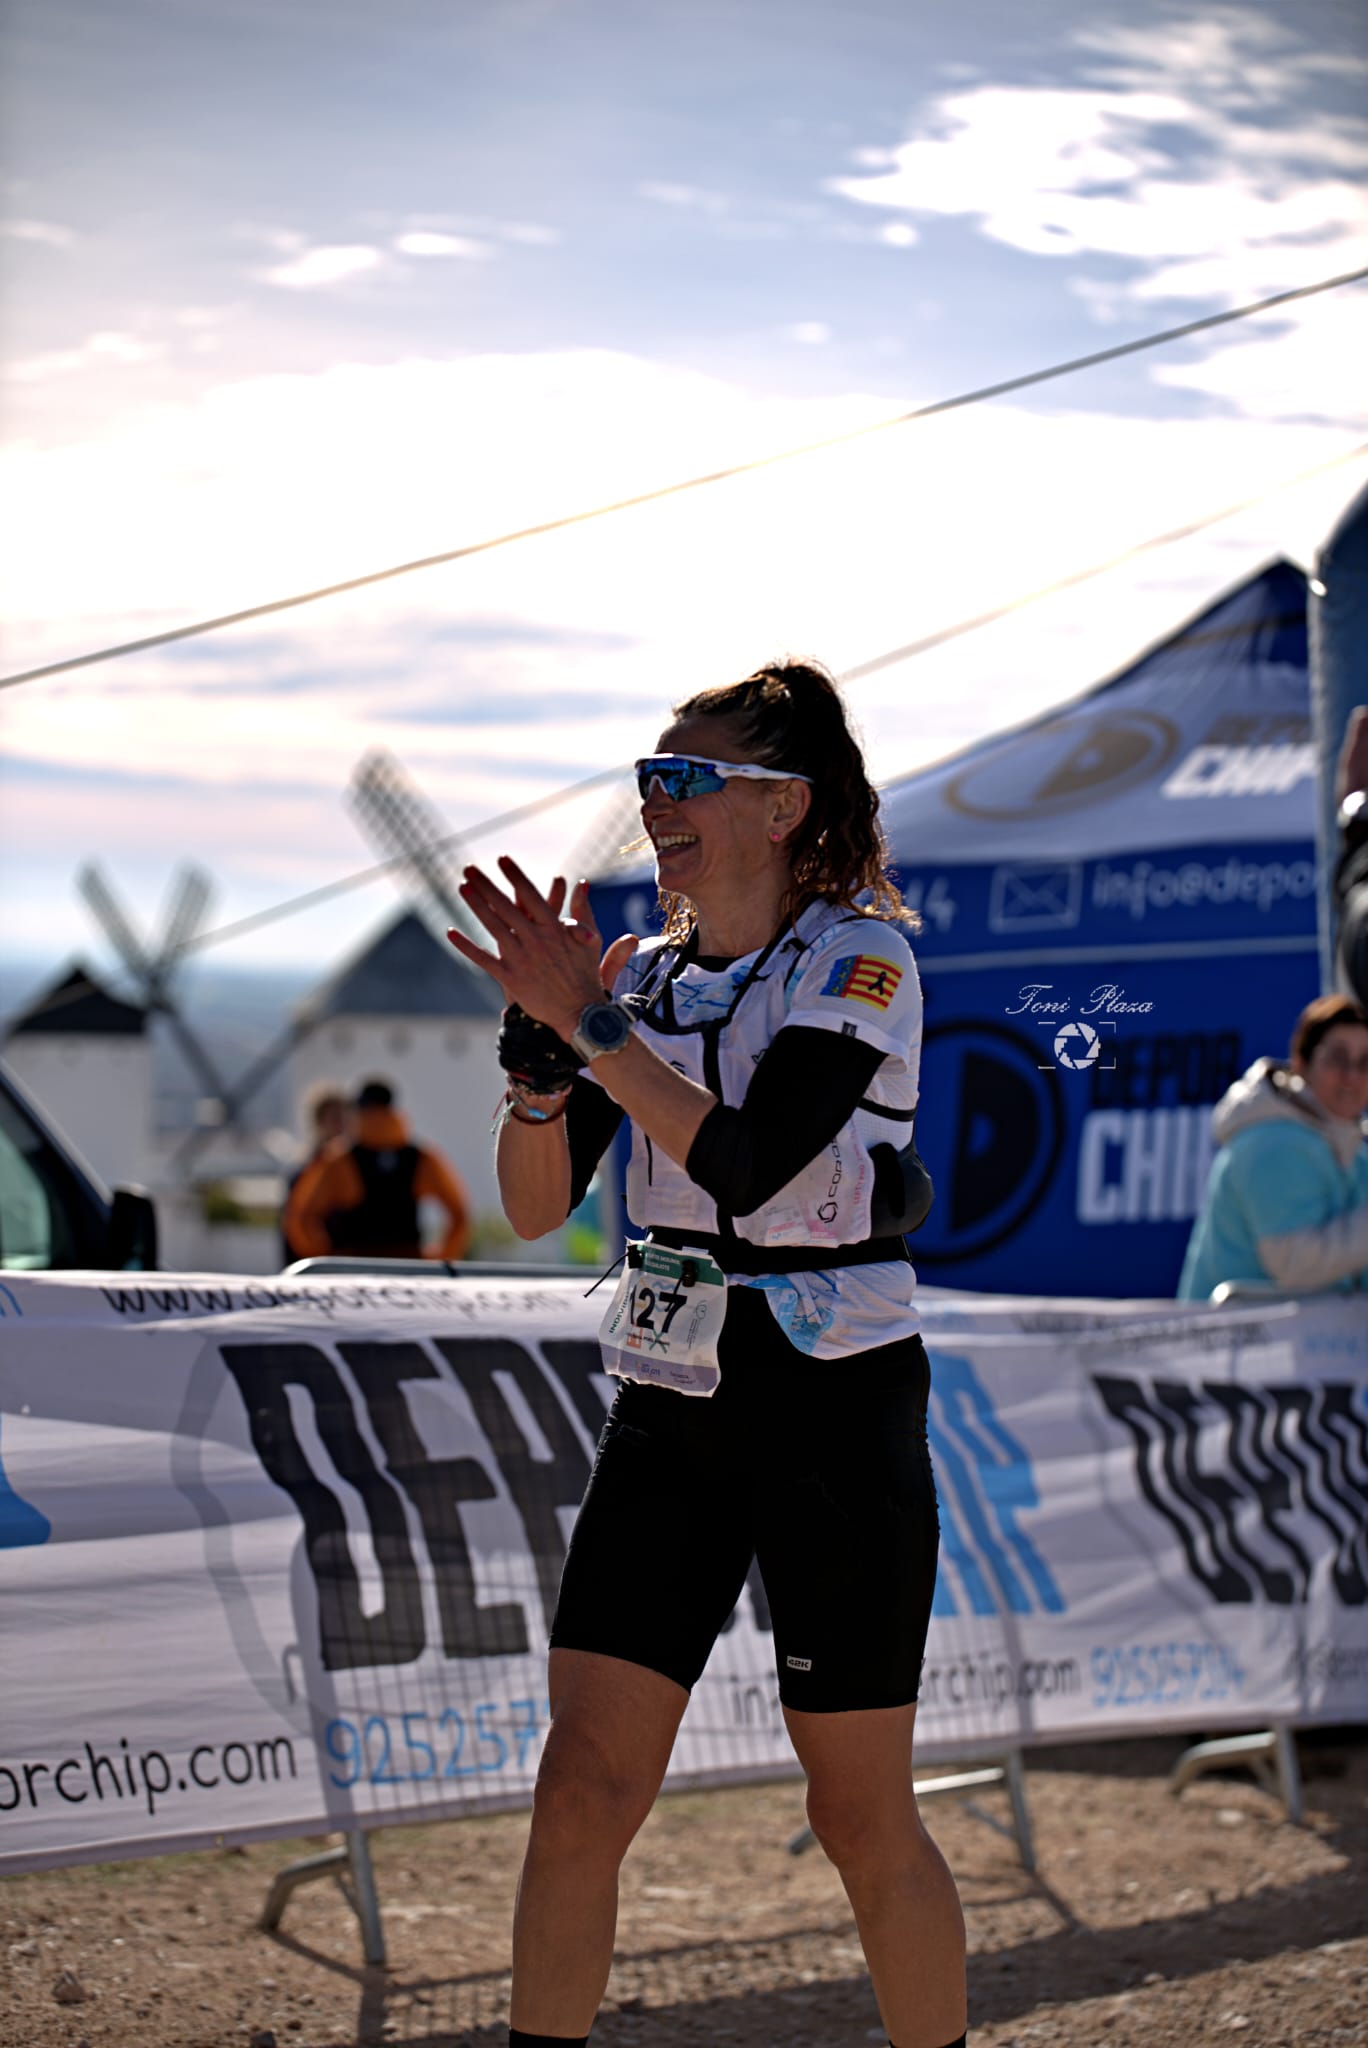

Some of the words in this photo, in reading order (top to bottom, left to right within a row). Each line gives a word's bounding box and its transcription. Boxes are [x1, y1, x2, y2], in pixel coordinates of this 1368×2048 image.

[1078, 1107, 1212, 1223] CHI
[630, 1284, 688, 1333] 127
[325, 1699, 550, 1789] 925257
